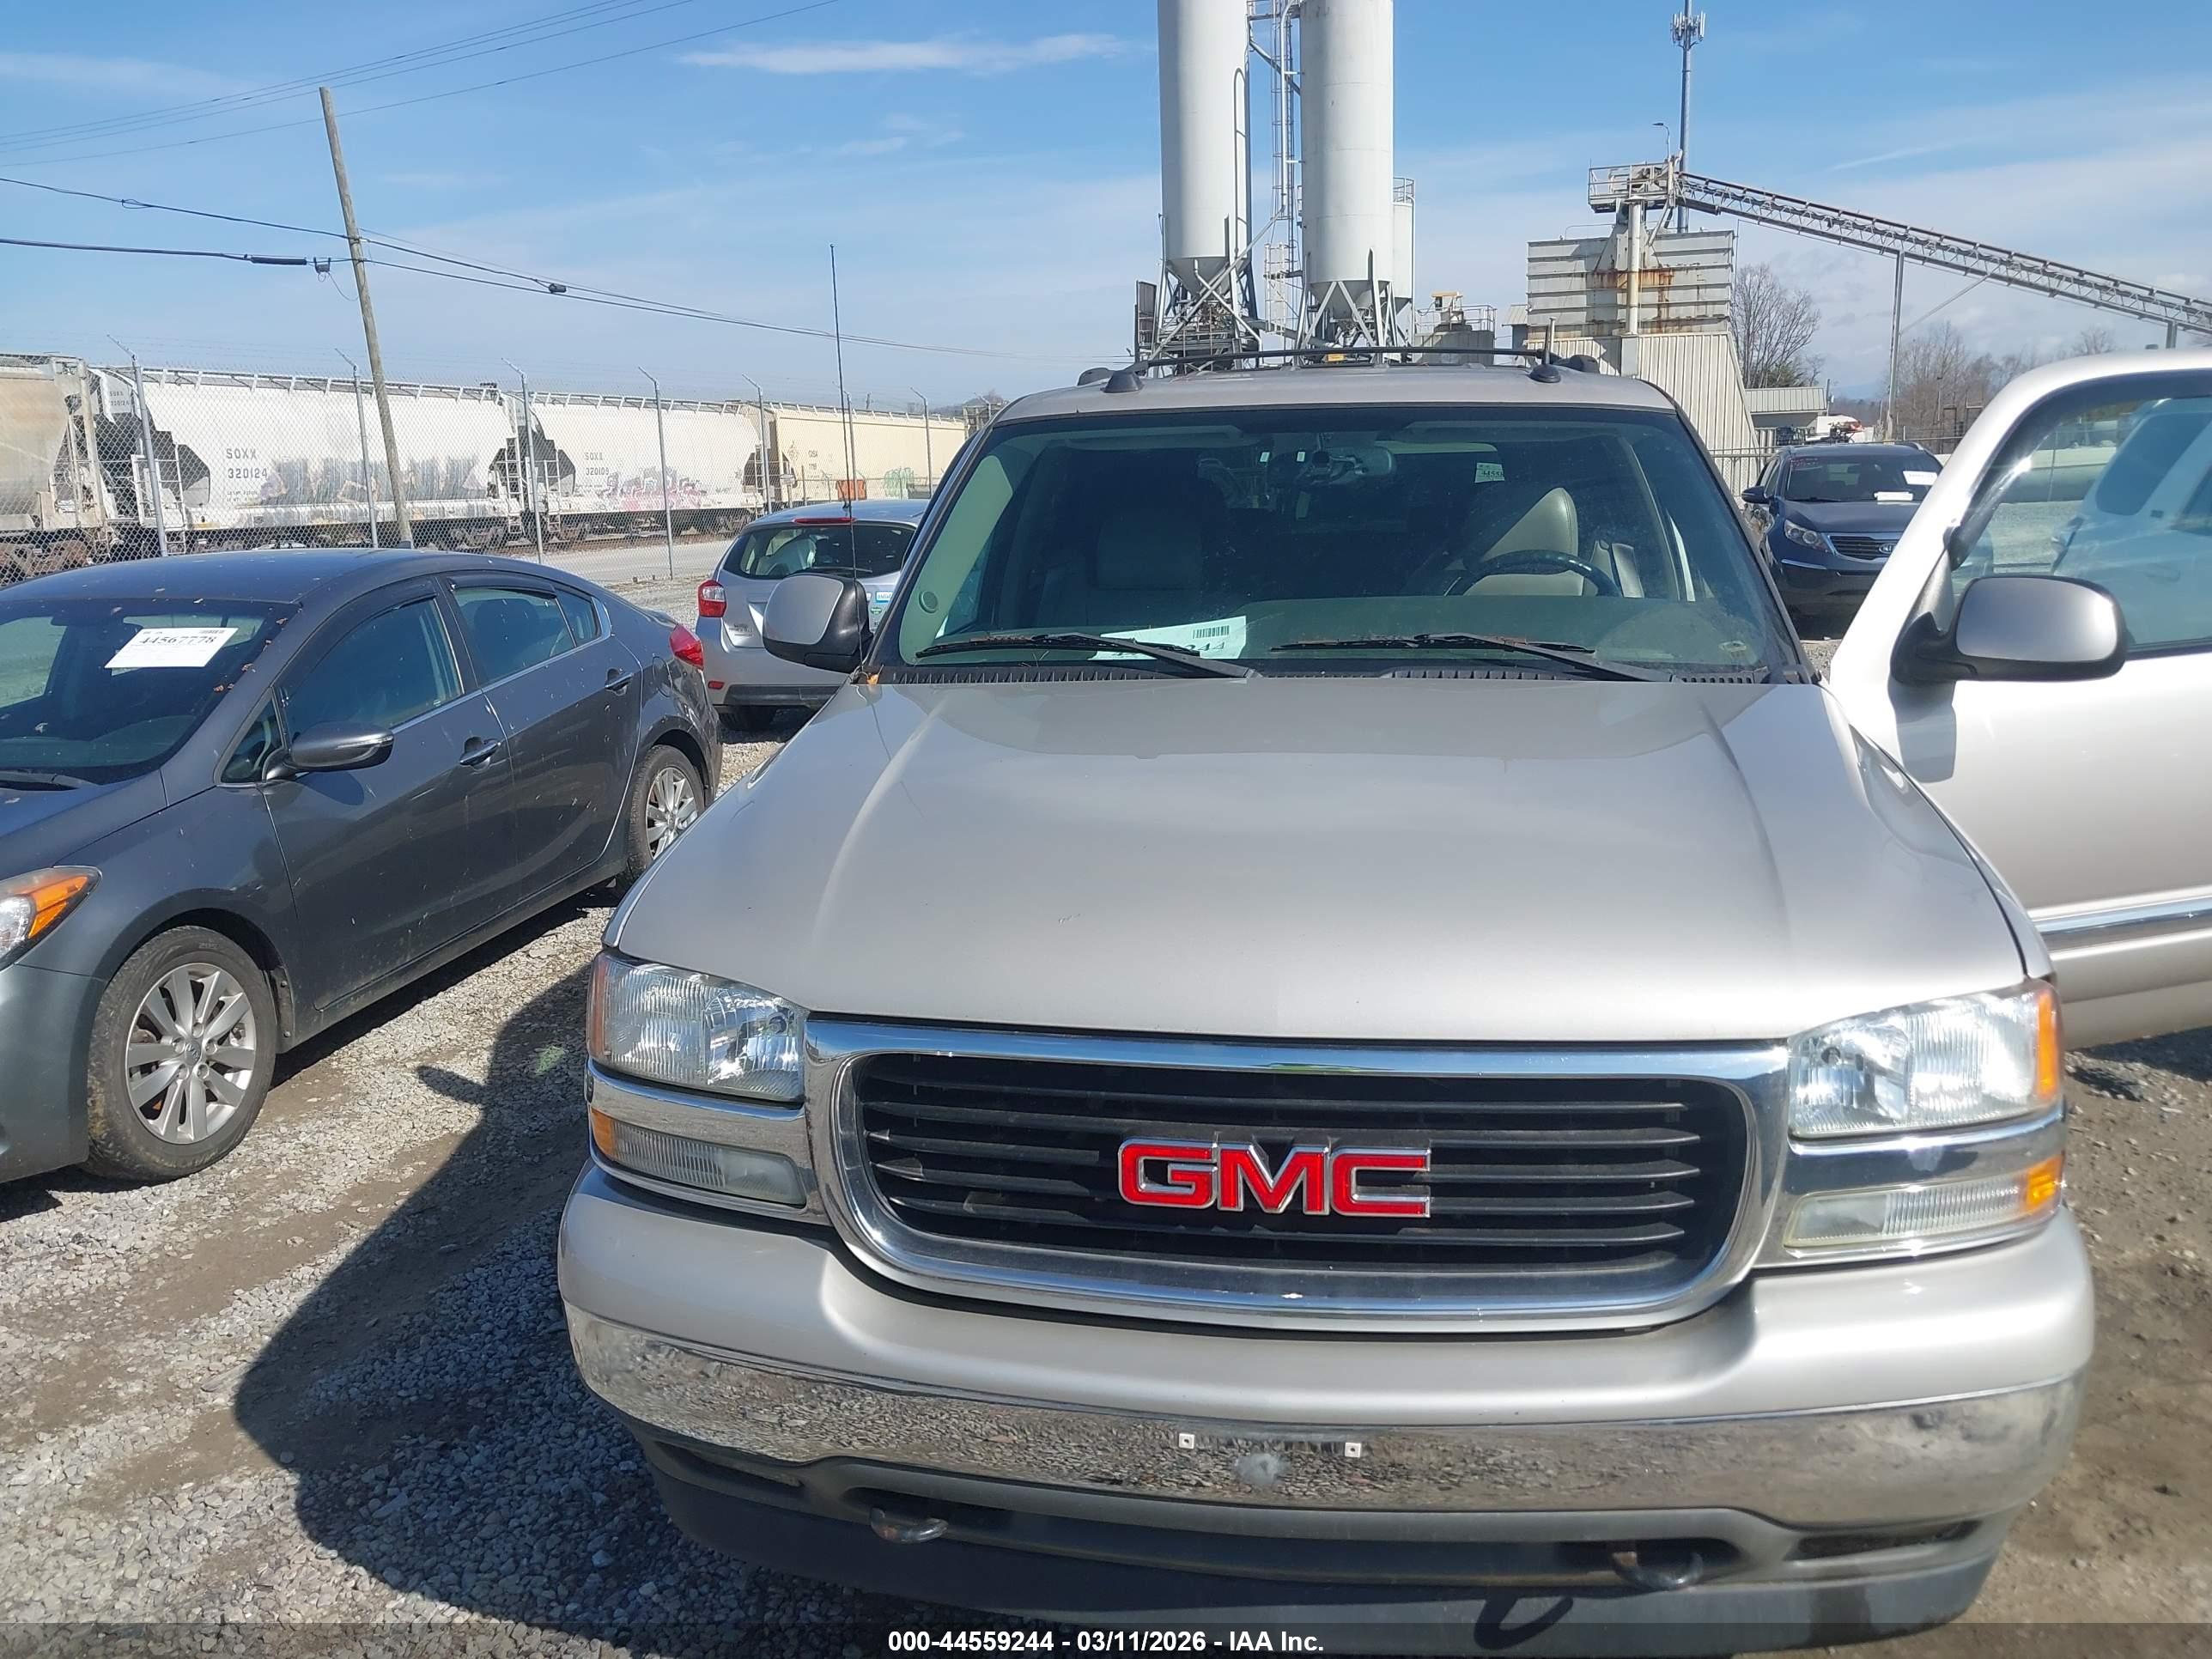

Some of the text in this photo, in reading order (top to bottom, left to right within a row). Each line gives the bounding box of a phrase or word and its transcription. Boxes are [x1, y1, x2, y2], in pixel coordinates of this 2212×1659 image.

[226, 447, 257, 460] SOXX
[228, 467, 268, 480] 320124
[139, 635, 216, 644] 44567778
[1118, 1137, 1431, 1218] GMC
